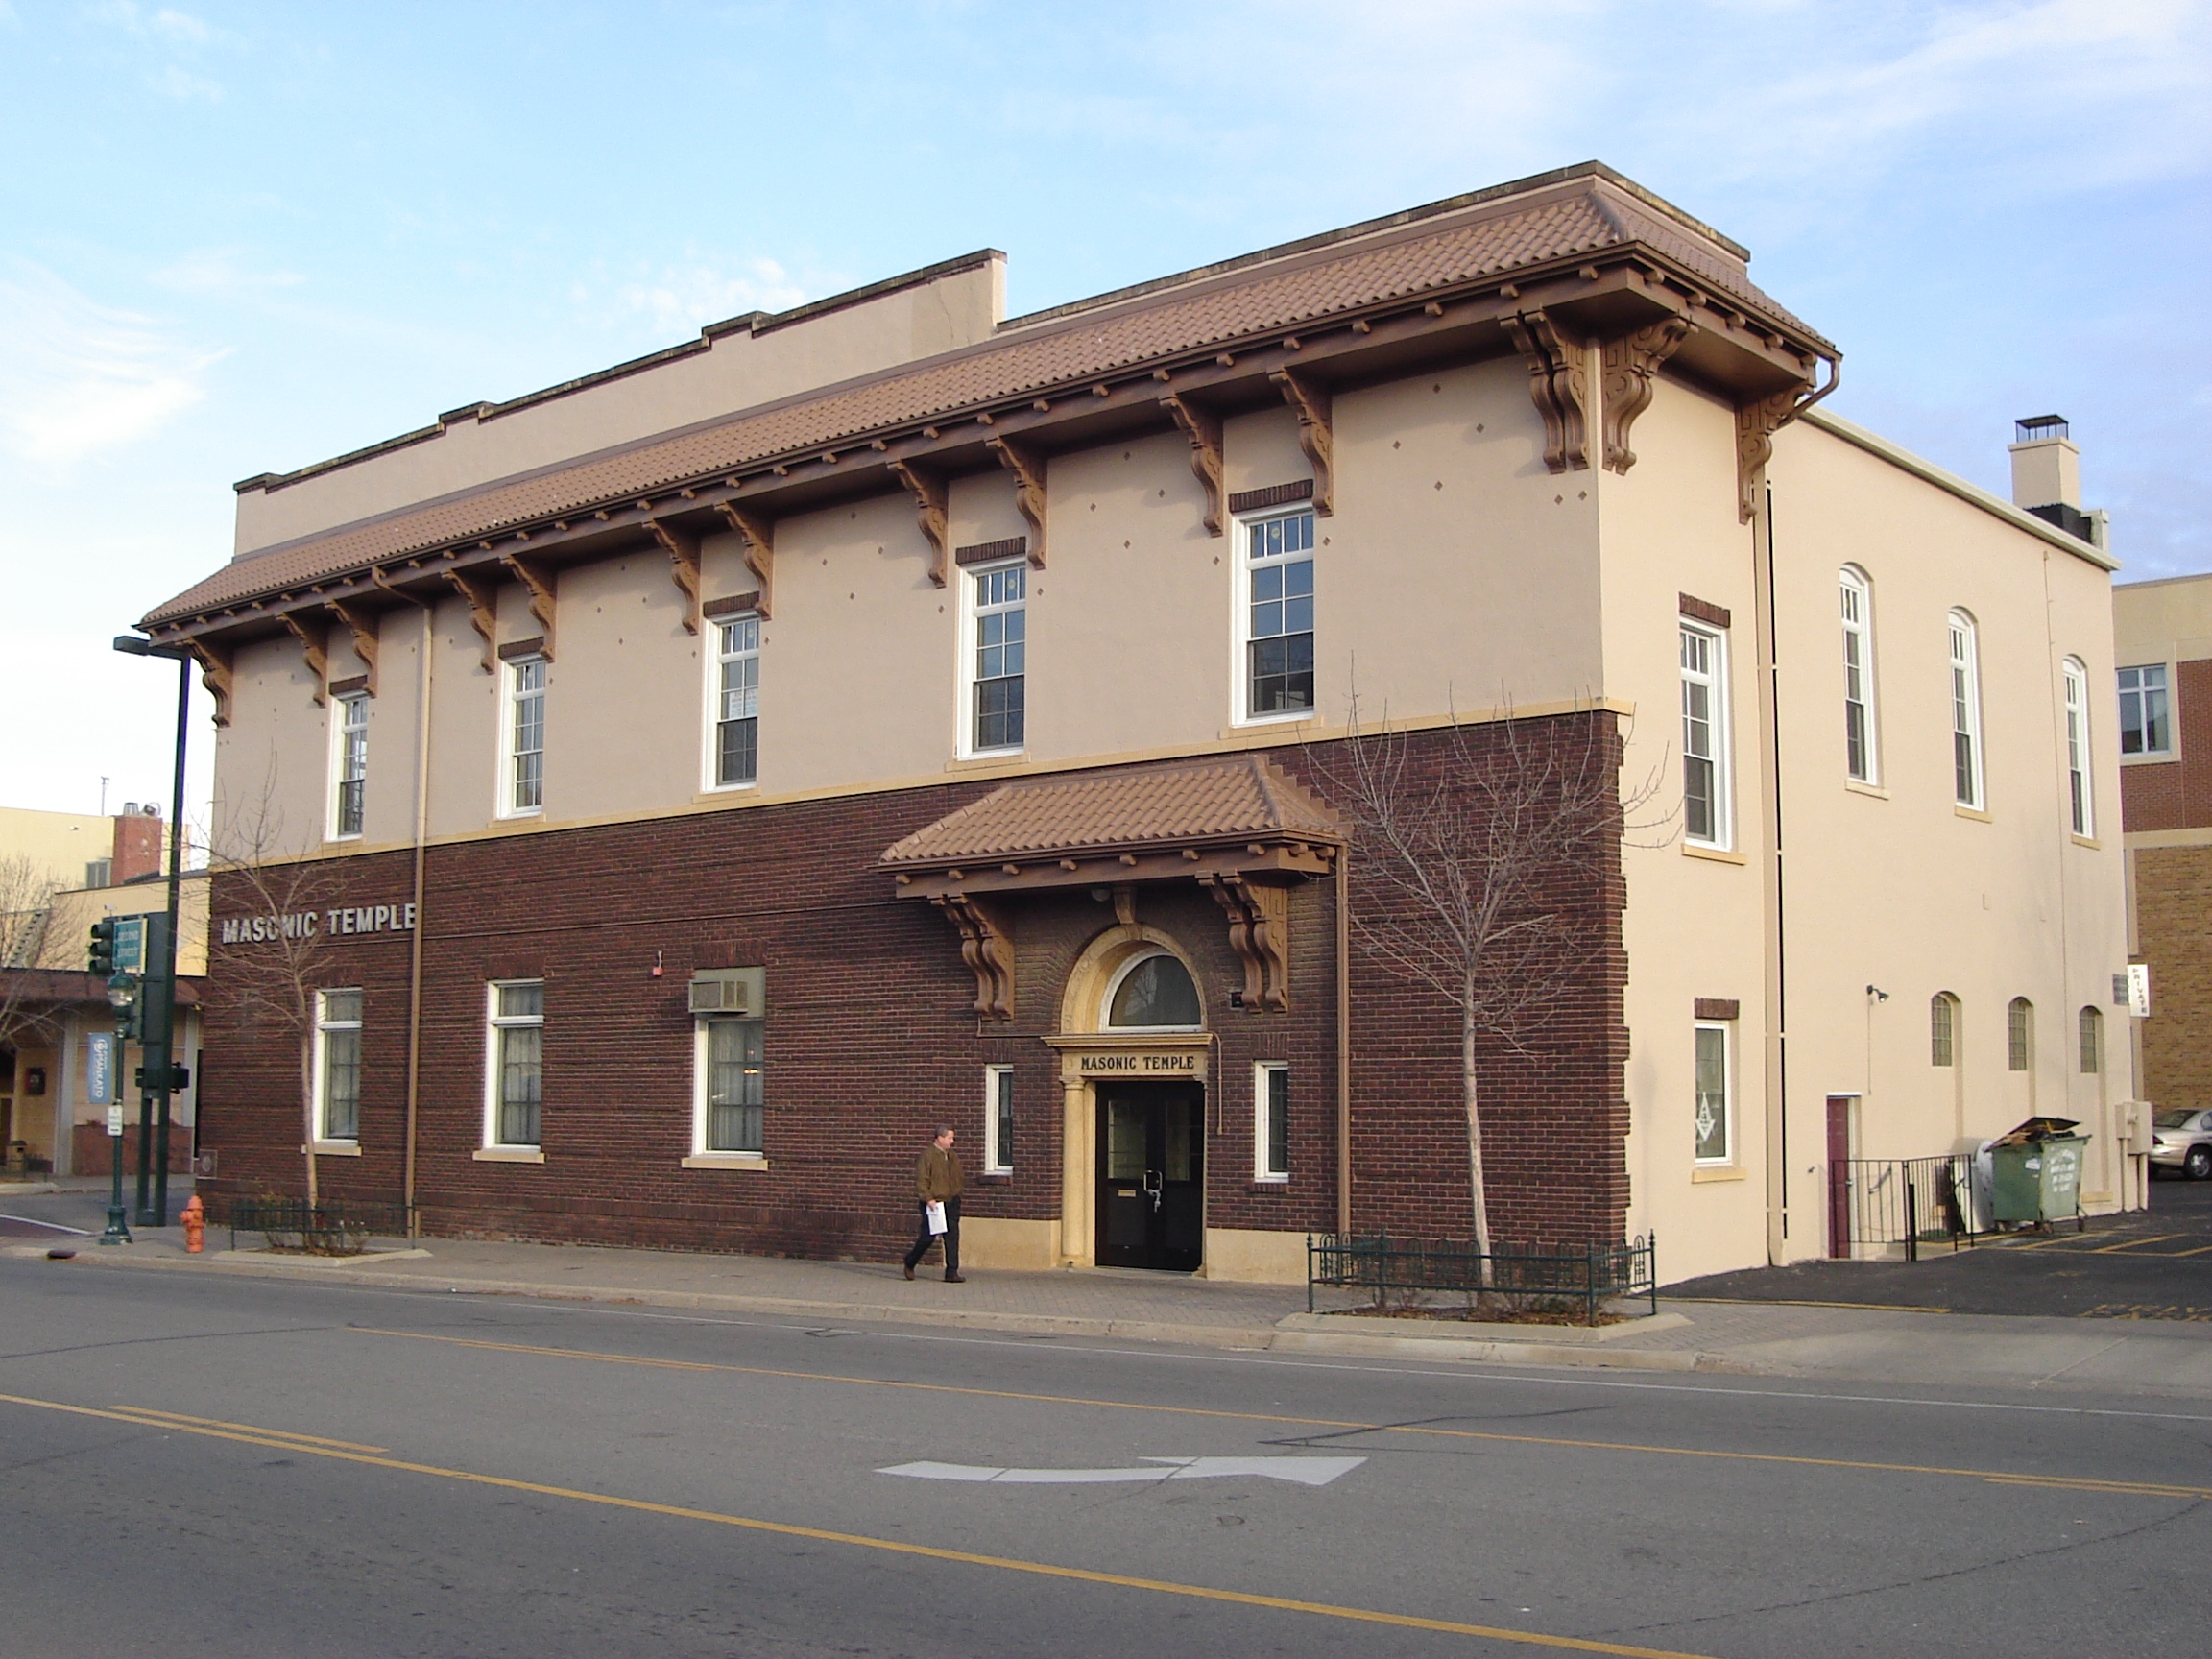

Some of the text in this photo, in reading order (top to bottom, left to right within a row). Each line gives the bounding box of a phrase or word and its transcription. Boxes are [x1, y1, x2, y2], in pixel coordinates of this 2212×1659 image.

[222, 902, 417, 945] MASONIC TEMPLE
[2131, 968, 2148, 1014] PRIVATE
[95, 1052, 104, 1098] MANKATO
[1081, 1056, 1195, 1070] MASONIC TEMPLE
